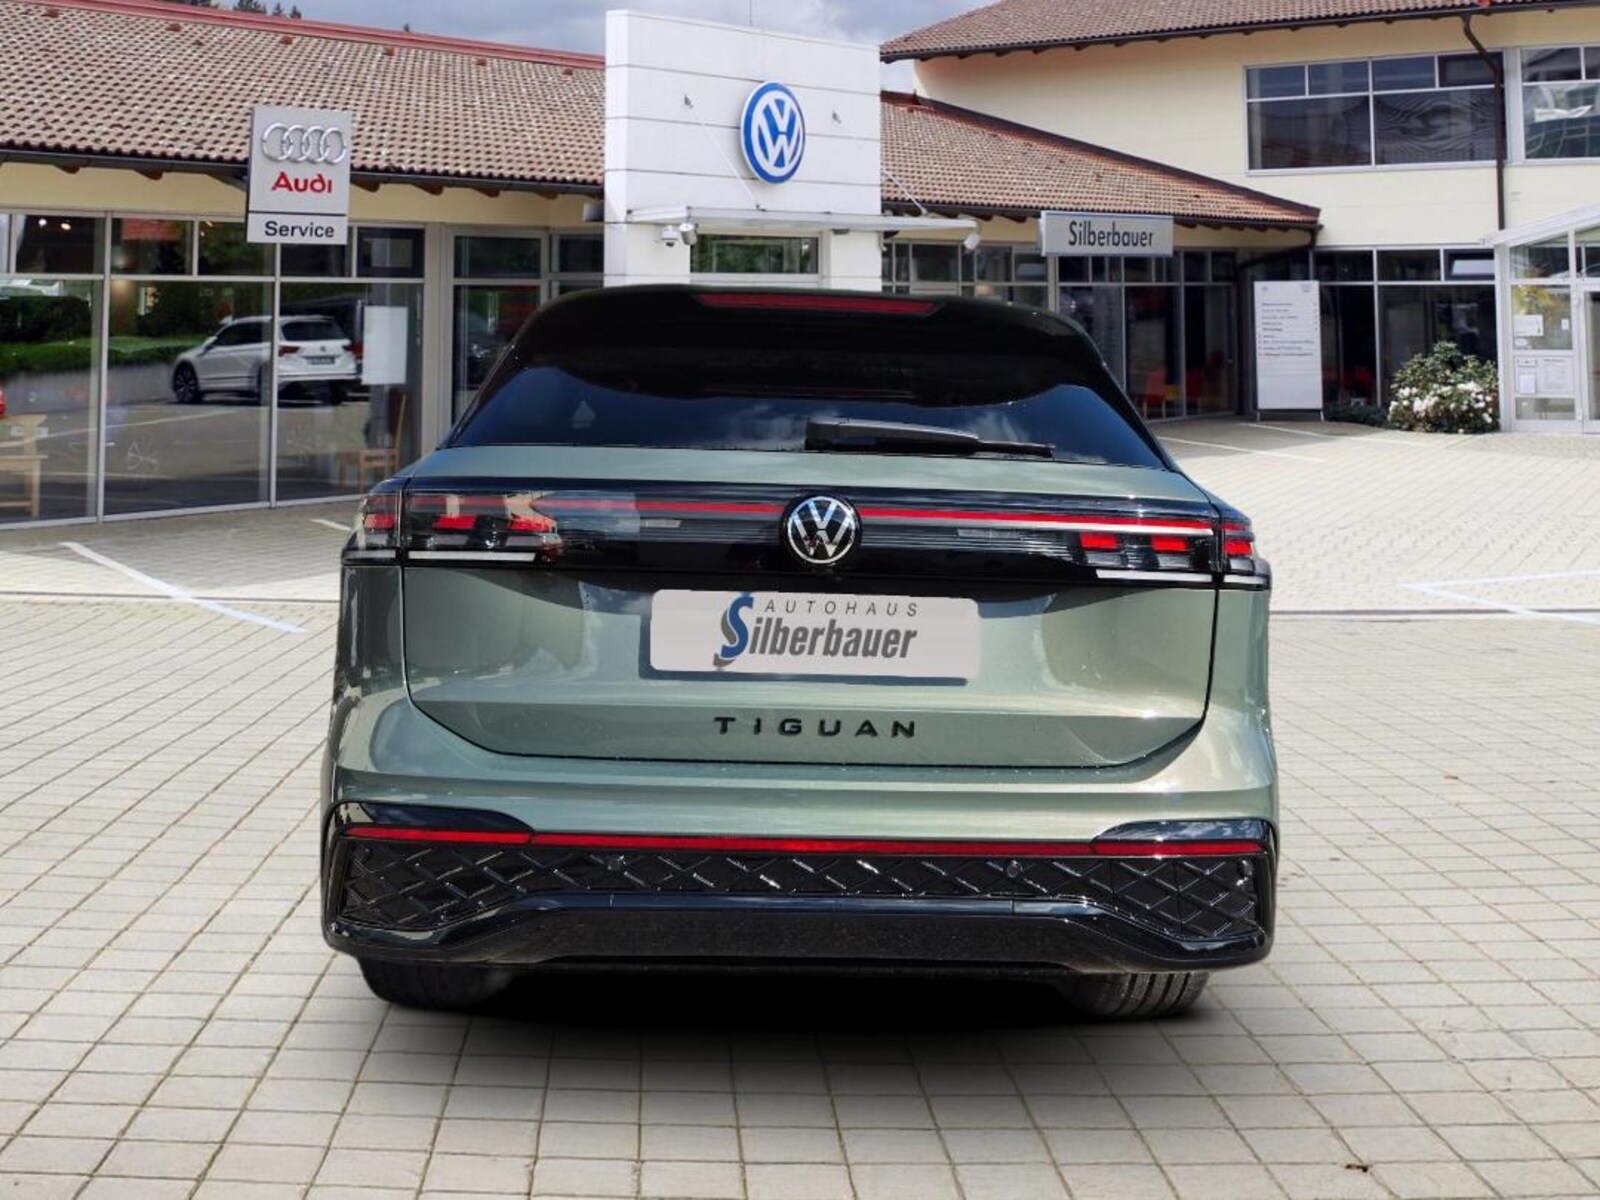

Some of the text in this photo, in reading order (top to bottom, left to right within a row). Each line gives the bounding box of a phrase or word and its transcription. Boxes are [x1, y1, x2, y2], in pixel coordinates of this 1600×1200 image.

[271, 171, 332, 193] Audi
[264, 220, 334, 238] Service
[1068, 220, 1154, 247] Silberbauer
[764, 600, 919, 617] AUTOHAUS
[714, 593, 918, 666] Silberbauer
[714, 717, 916, 738] TIGUAN
